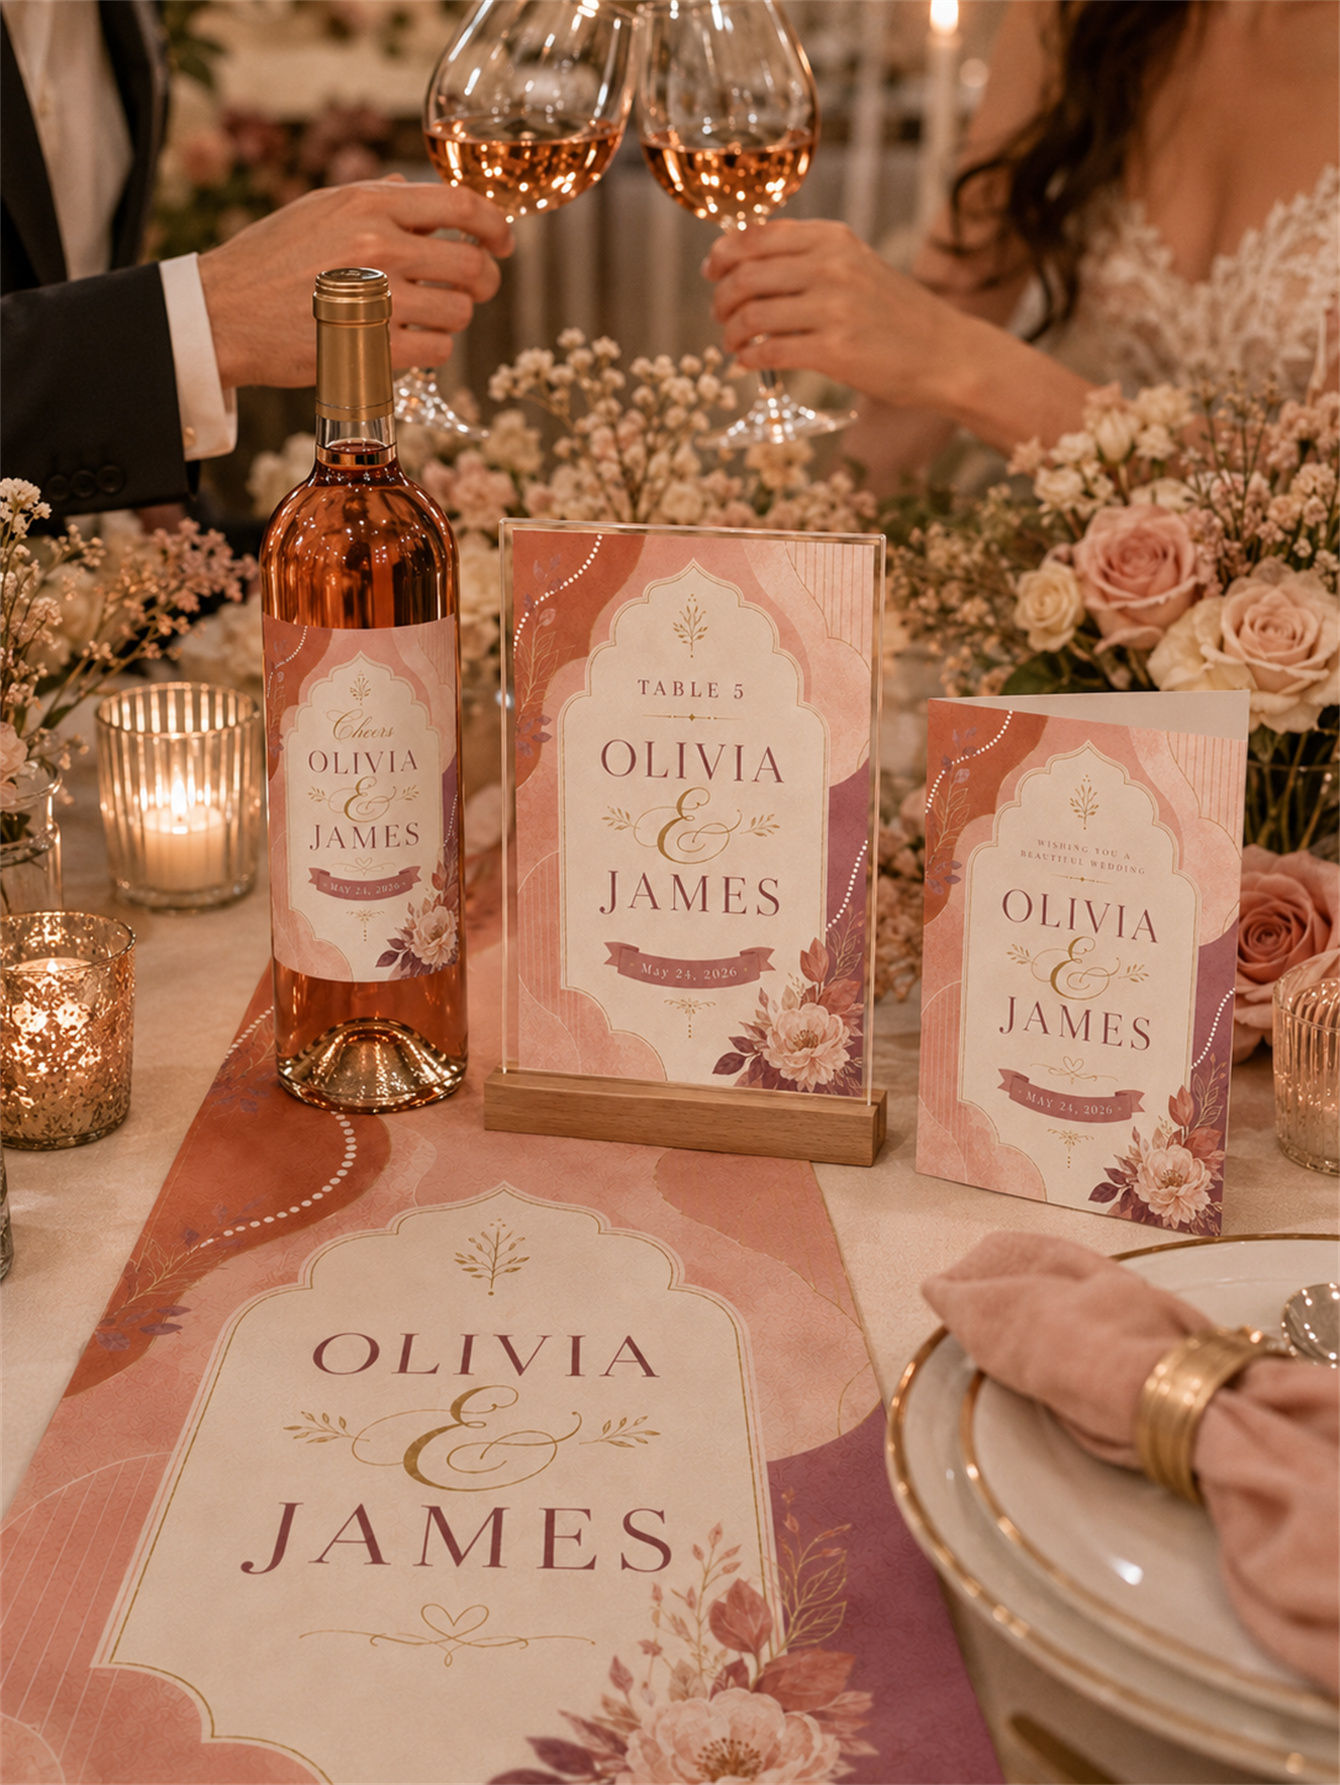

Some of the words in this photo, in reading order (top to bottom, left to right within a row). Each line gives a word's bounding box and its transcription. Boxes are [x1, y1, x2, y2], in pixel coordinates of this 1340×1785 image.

[637, 679, 719, 699] TABLE
[733, 683, 744, 699] 5
[326, 708, 394, 741] Cheers
[308, 750, 418, 775] OLIVIA
[600, 738, 785, 784] OLIVIA
[327, 775, 397, 823] &
[309, 822, 420, 851] JAMES
[633, 786, 743, 865] &
[1037, 839, 1088, 853] WISHING
[1095, 847, 1118, 858] YOU
[1020, 849, 1083, 866] BEAUTIFUL
[1090, 859, 1145, 875] WEDDING
[330, 882, 351, 894] MAY
[599, 870, 781, 917] JAMES
[1002, 888, 1159, 944] OLIVIA
[641, 963, 669, 979] May
[675, 968, 696, 981] 24,
[703, 967, 737, 980] 2026
[1031, 936, 1121, 1001] &
[999, 996, 1151, 1051] JAMES
[1025, 1091, 1054, 1108] MAY
[1059, 1101, 1078, 1115] 24,
[1083, 1104, 1113, 1115] 2026
[312, 1332, 661, 1378] OLIVIA
[351, 1384, 582, 1492] &
[239, 1502, 673, 1575] JAMES
